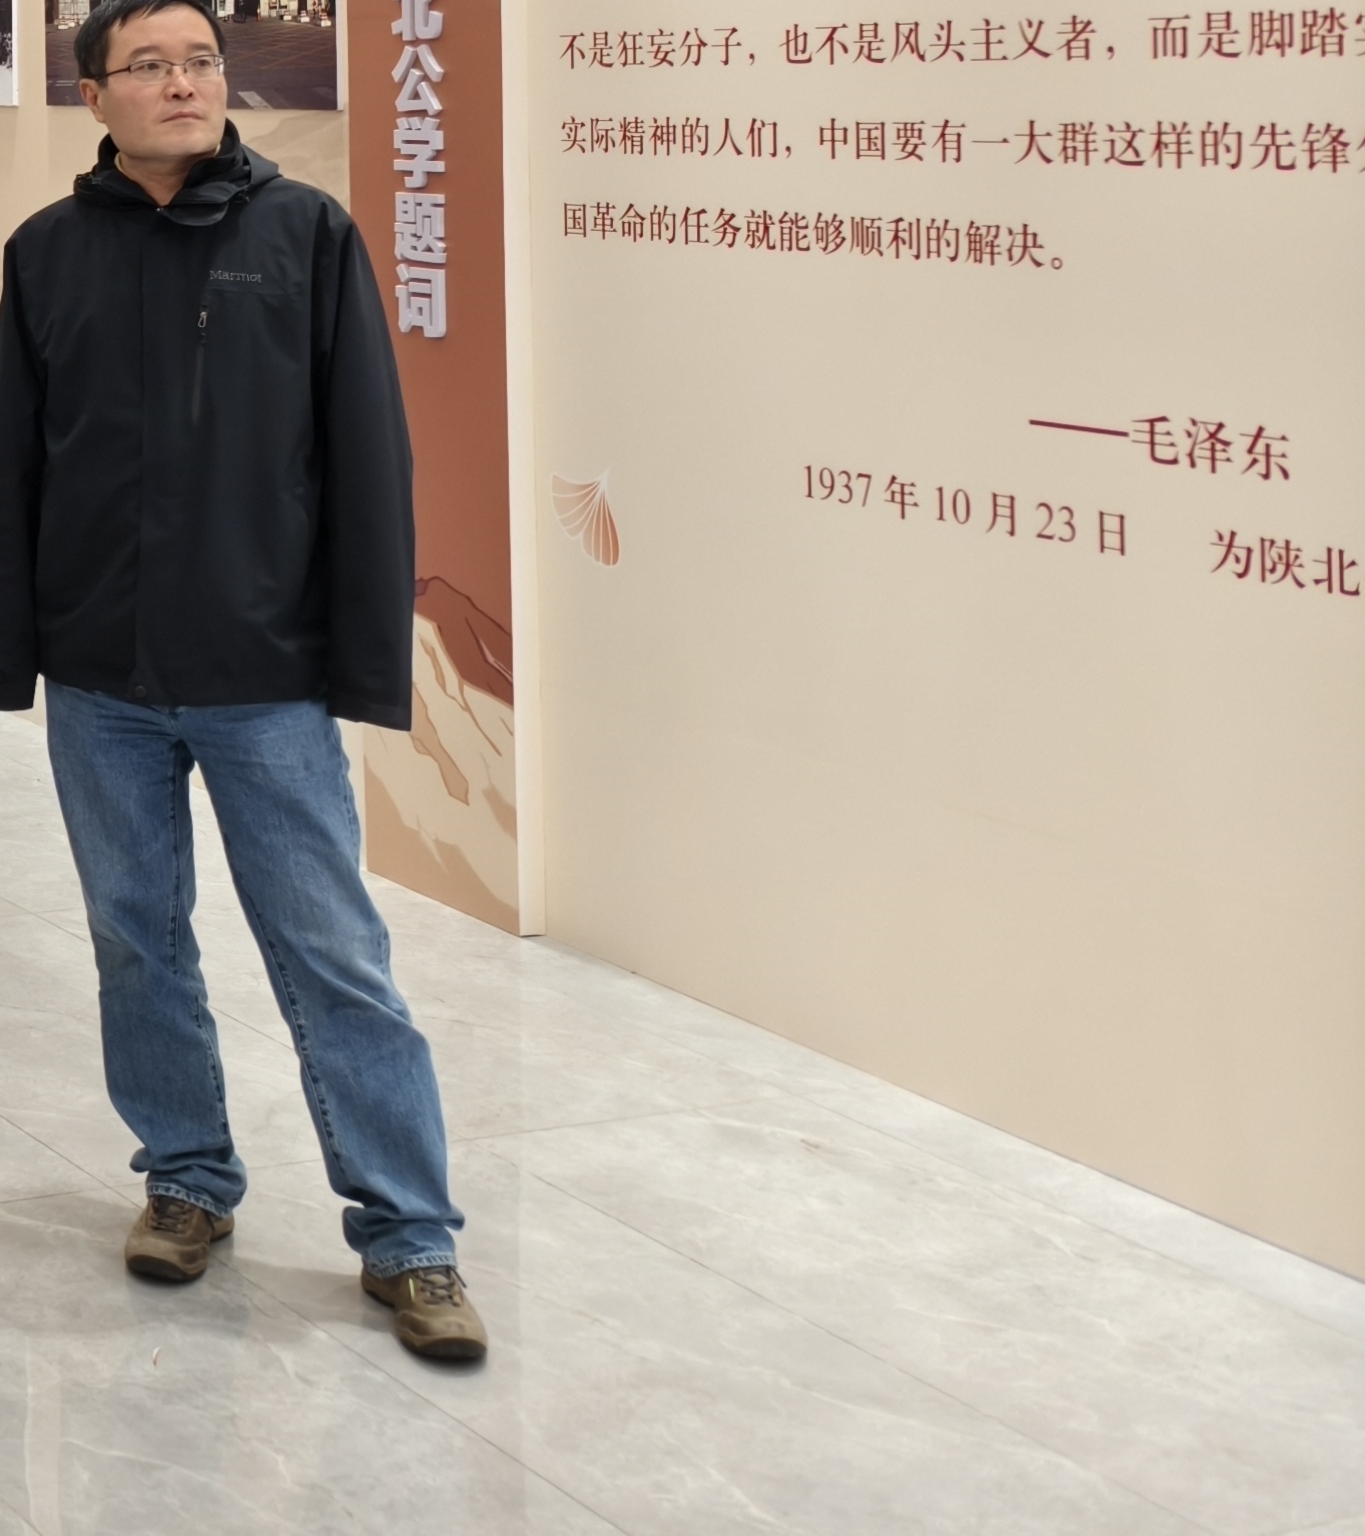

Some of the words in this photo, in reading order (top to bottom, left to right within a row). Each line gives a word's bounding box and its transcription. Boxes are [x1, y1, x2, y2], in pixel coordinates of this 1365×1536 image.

[558, 6, 1365, 69] 不是狂妄分子，也不是风头主义者，而是脚踏
[560, 115, 1365, 173] 实际精神的人们，中国要有一大群这样的先锋
[562, 201, 1065, 272] 国革命的任务就能够顺利的解决。
[209, 270, 262, 283] Marmot
[1209, 528, 1362, 598] 为陕北
